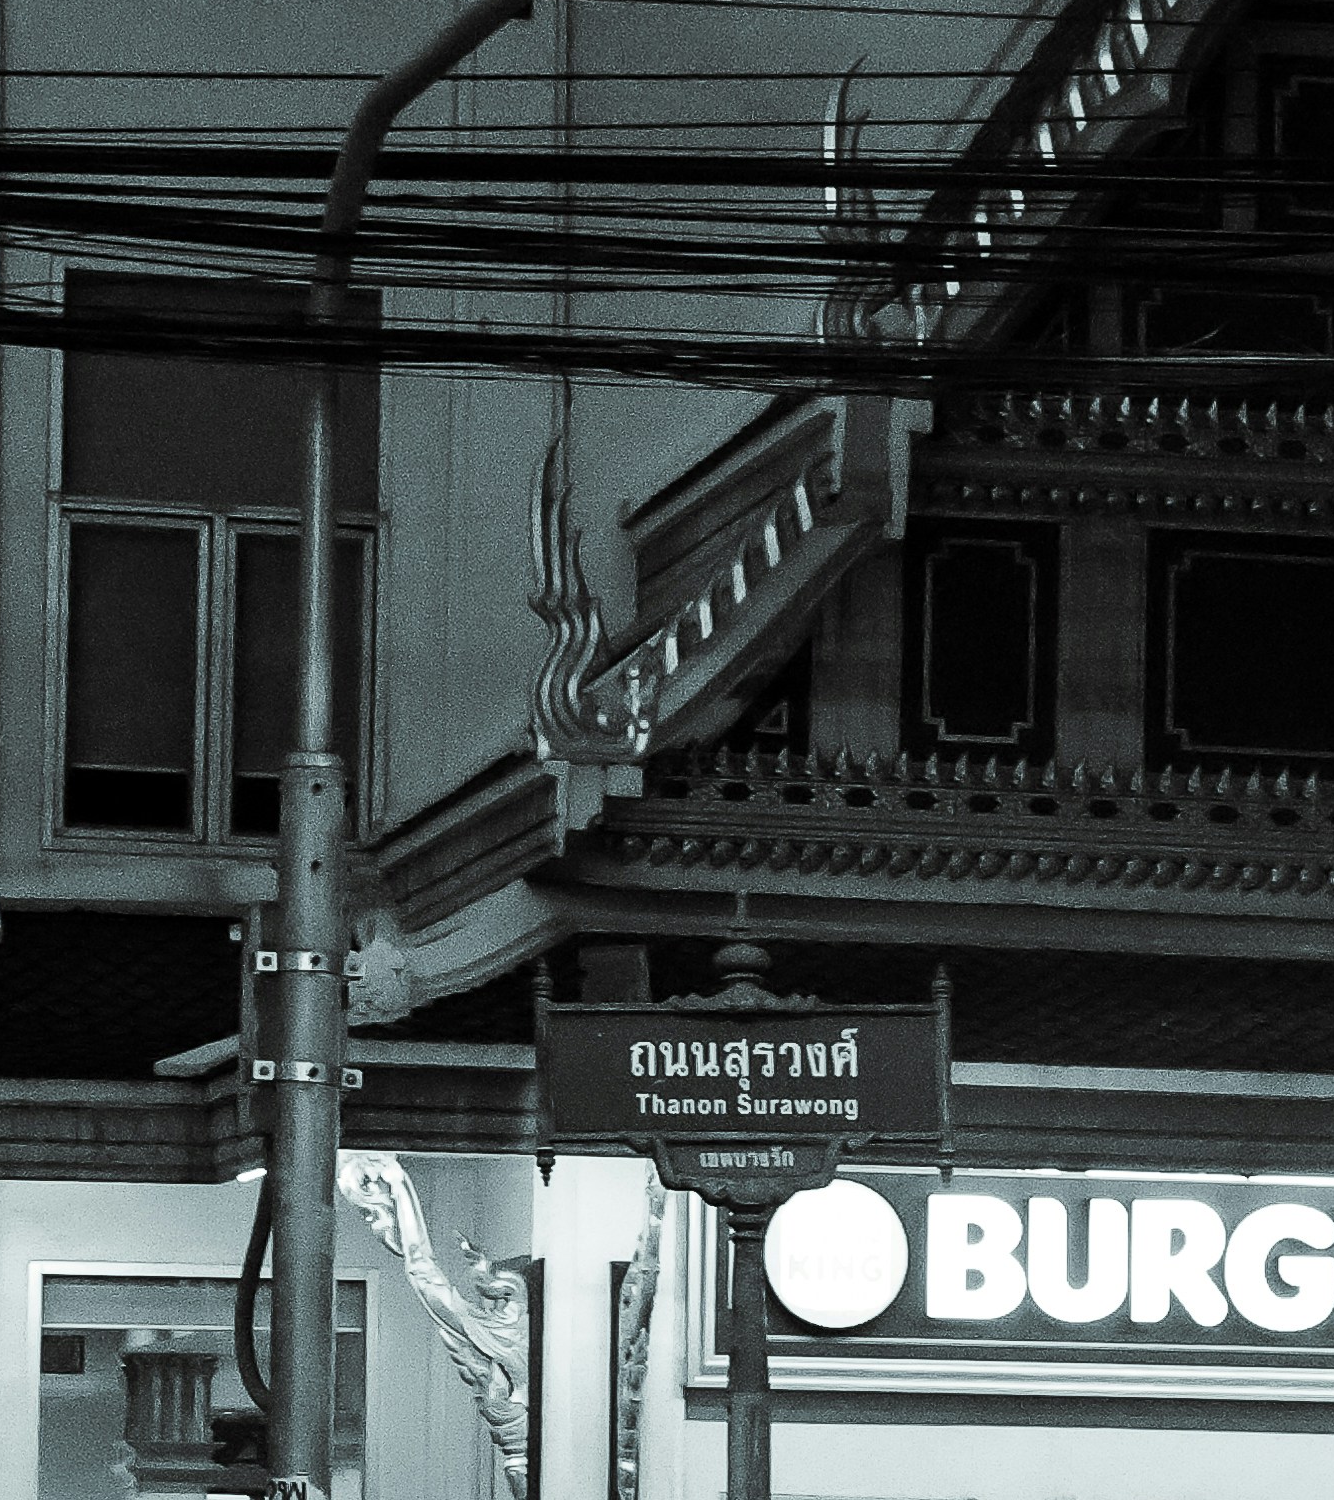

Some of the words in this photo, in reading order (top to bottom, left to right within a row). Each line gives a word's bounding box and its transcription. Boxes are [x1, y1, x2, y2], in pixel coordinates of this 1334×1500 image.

[629, 1027, 859, 1090] ถนนสุรวงศ์
[636, 1093, 727, 1115] Thanon
[737, 1093, 859, 1121] Surawong
[788, 1254, 882, 1283] KING
